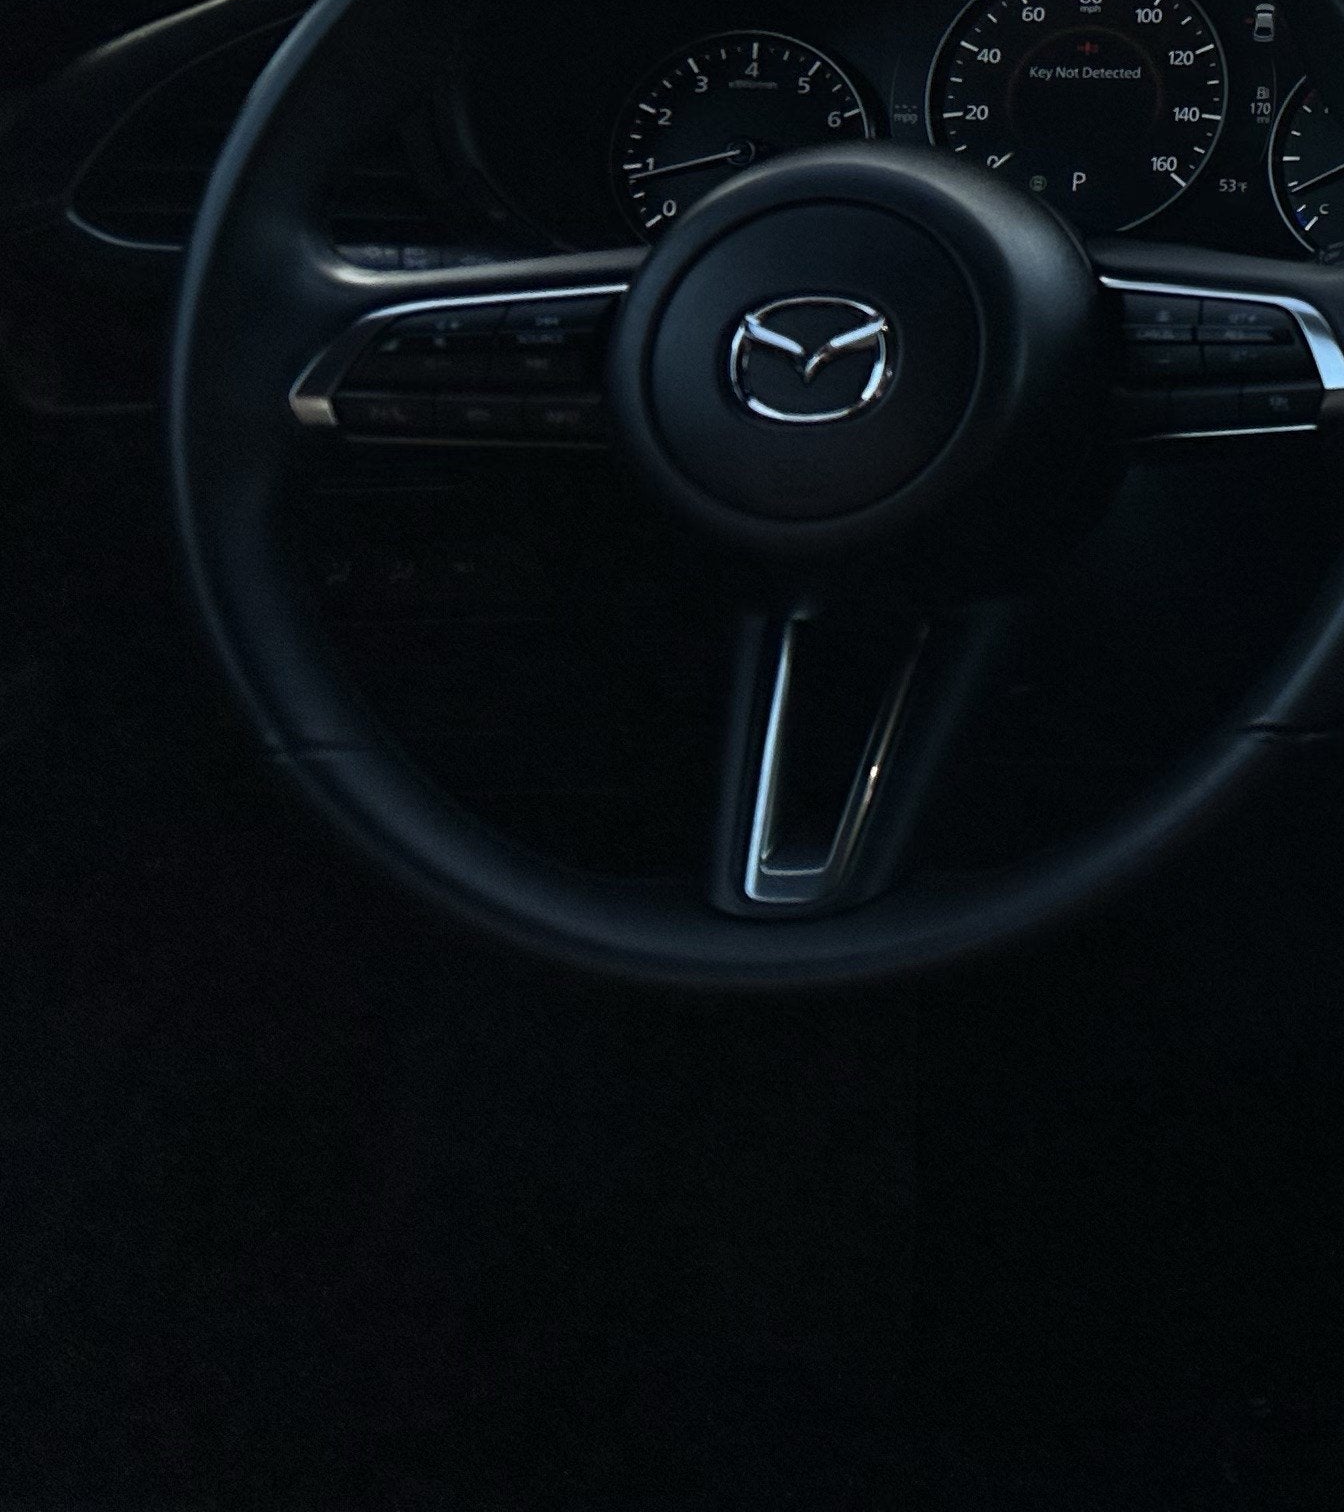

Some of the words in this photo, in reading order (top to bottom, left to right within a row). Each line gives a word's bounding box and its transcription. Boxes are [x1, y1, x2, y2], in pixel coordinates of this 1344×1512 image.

[1022, 8, 1045, 22] 60
[1135, 9, 1162, 23] 100
[978, 49, 1001, 64] 40
[1169, 50, 1194, 66] 120
[745, 62, 759, 77] 4
[1029, 67, 1051, 81] Key
[1056, 68, 1079, 79] Not
[1083, 67, 1142, 79] Detected
[695, 76, 708, 93] 3
[798, 77, 810, 94] 5
[965, 105, 988, 120] 20
[1173, 107, 1200, 122] 140
[1250, 102, 1271, 115] 170
[658, 109, 672, 125] 2
[827, 111, 841, 127] 6
[646, 157, 655, 170] 1
[1150, 156, 1177, 171] 160
[1072, 172, 1086, 191] P
[662, 199, 677, 216] 0
[1320, 203, 1329, 214] C
